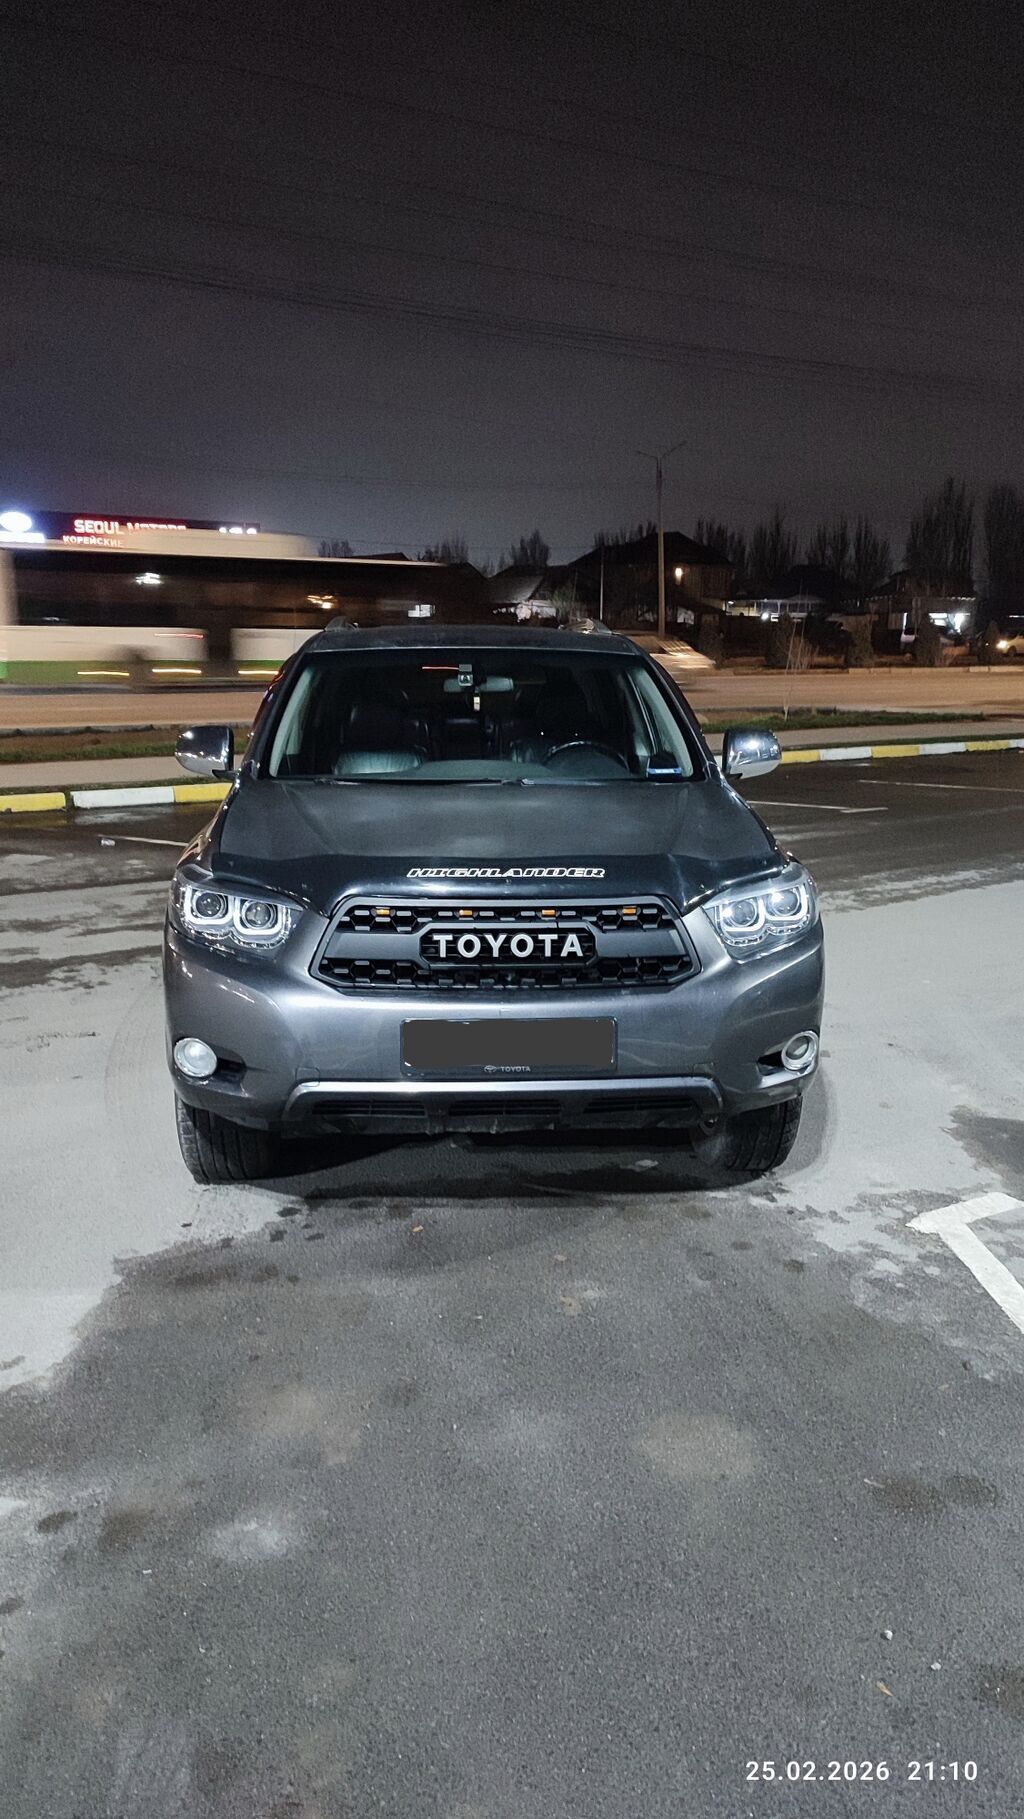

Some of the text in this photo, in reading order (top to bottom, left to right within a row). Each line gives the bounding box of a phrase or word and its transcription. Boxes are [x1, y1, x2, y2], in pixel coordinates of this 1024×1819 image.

[74, 519, 125, 535] SEOUL
[62, 535, 124, 548] КОРЕЙСКИЕ
[406, 867, 606, 878] HIGHLANDER
[432, 933, 584, 958] TOYOTA
[500, 1065, 531, 1073] TOYOTA
